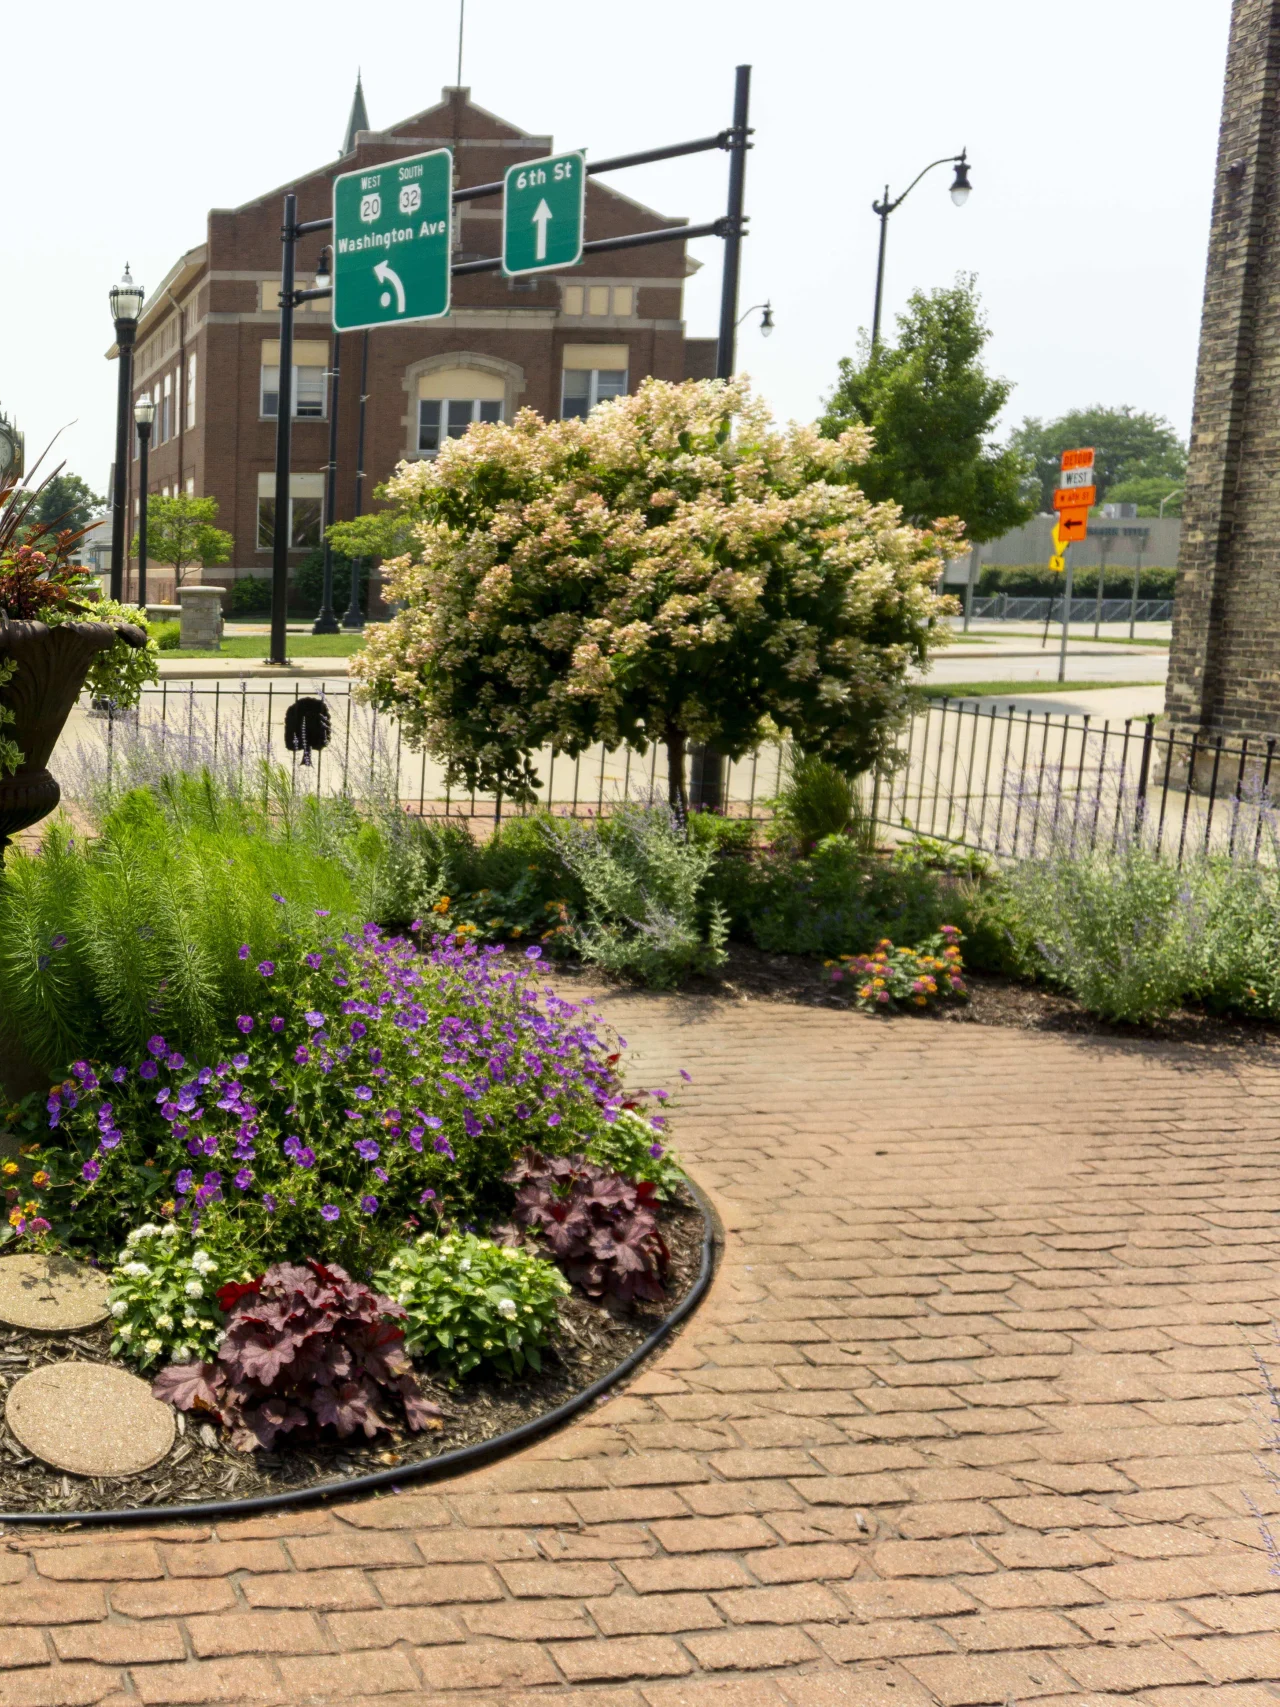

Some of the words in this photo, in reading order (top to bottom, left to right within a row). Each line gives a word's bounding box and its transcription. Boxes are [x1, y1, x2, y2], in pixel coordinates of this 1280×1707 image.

[398, 164, 424, 181] SOUTH
[516, 167, 547, 190] 6th
[553, 162, 573, 180] St
[361, 174, 381, 191] WEST
[402, 190, 419, 208] 32
[363, 200, 380, 218] 20
[338, 226, 413, 253] Washington
[419, 220, 446, 237] Ave
[1064, 452, 1093, 466] DETOUR
[1066, 472, 1088, 485] WEST
